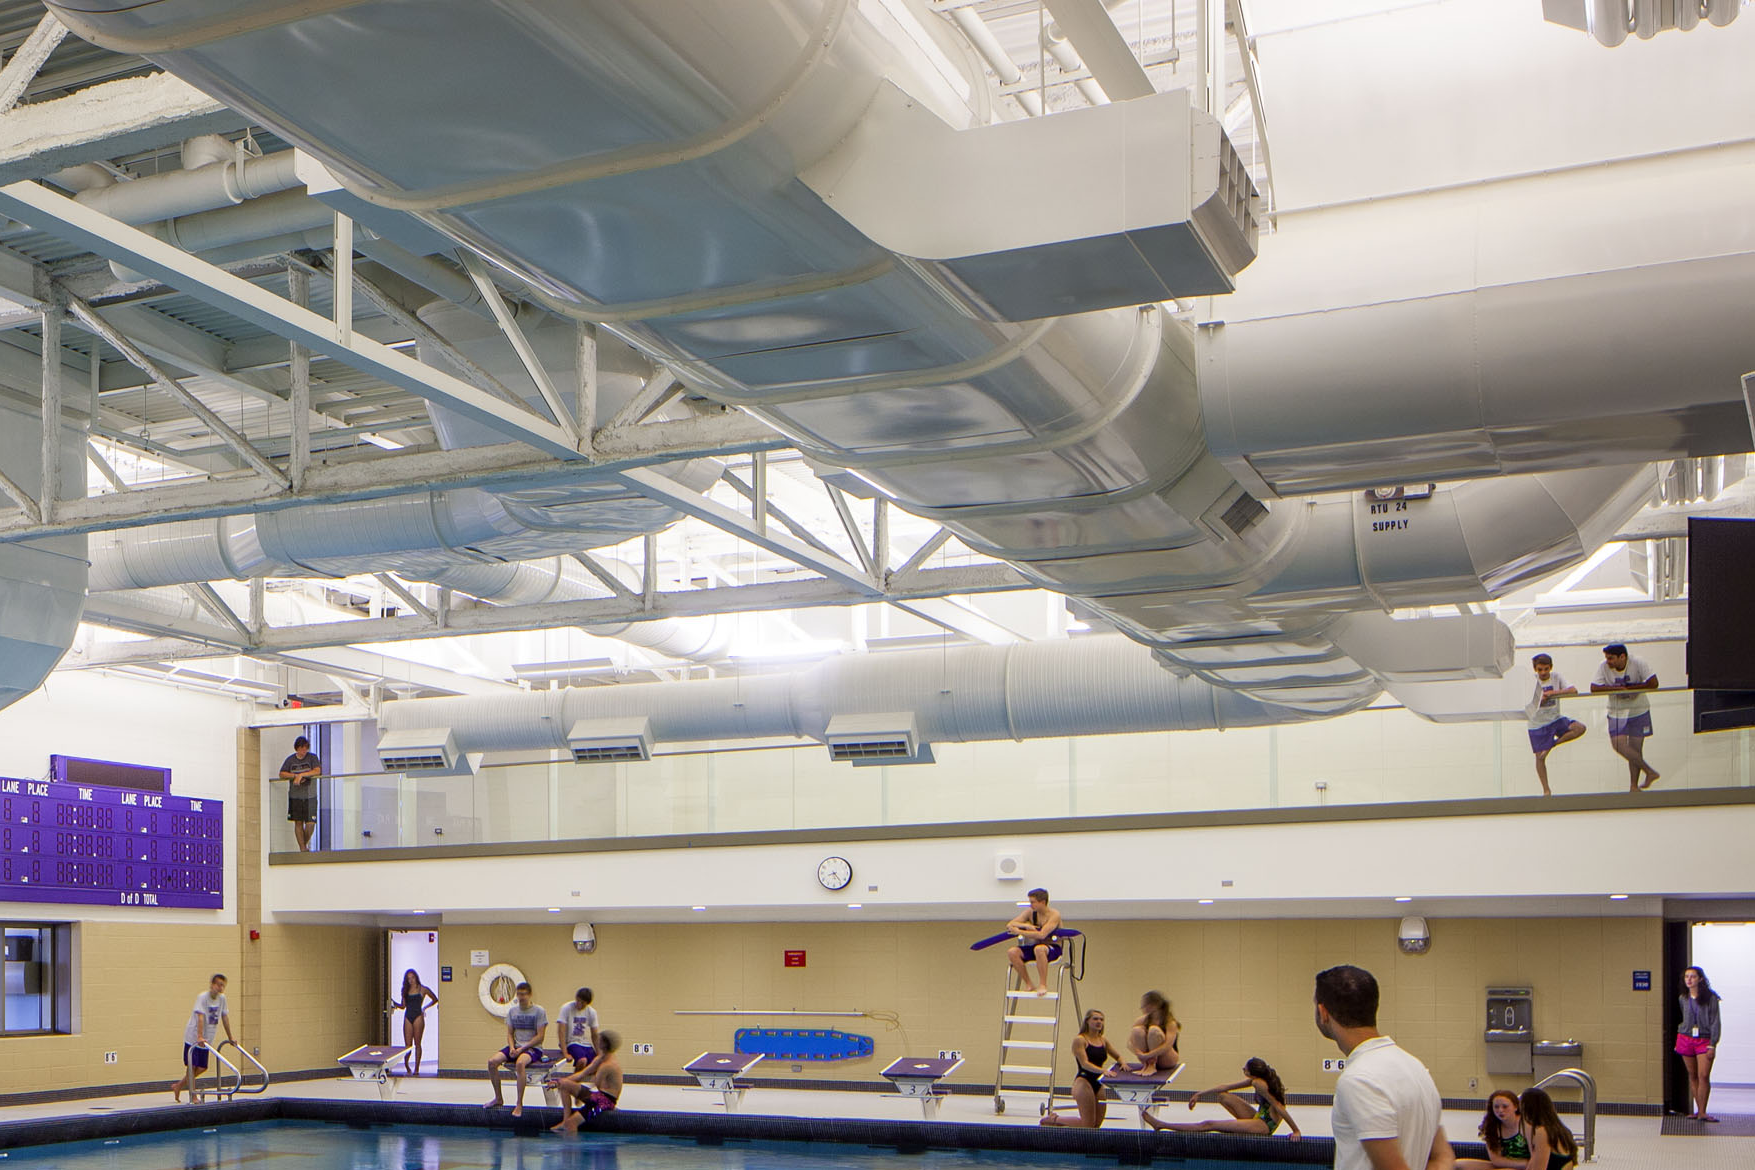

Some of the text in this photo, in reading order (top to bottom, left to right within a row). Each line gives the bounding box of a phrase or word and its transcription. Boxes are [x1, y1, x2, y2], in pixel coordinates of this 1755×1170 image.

[1371, 501, 1407, 514] RTU 24
[1372, 519, 1409, 532] SUPPLY
[1, 780, 203, 812] LANE PLACE TIME LANE PLACE TIME
[120, 892, 159, 906] D of D TOTAL
[709, 1079, 716, 1089] 4
[909, 1084, 916, 1095] 3
[1130, 1090, 1137, 1101] 2
